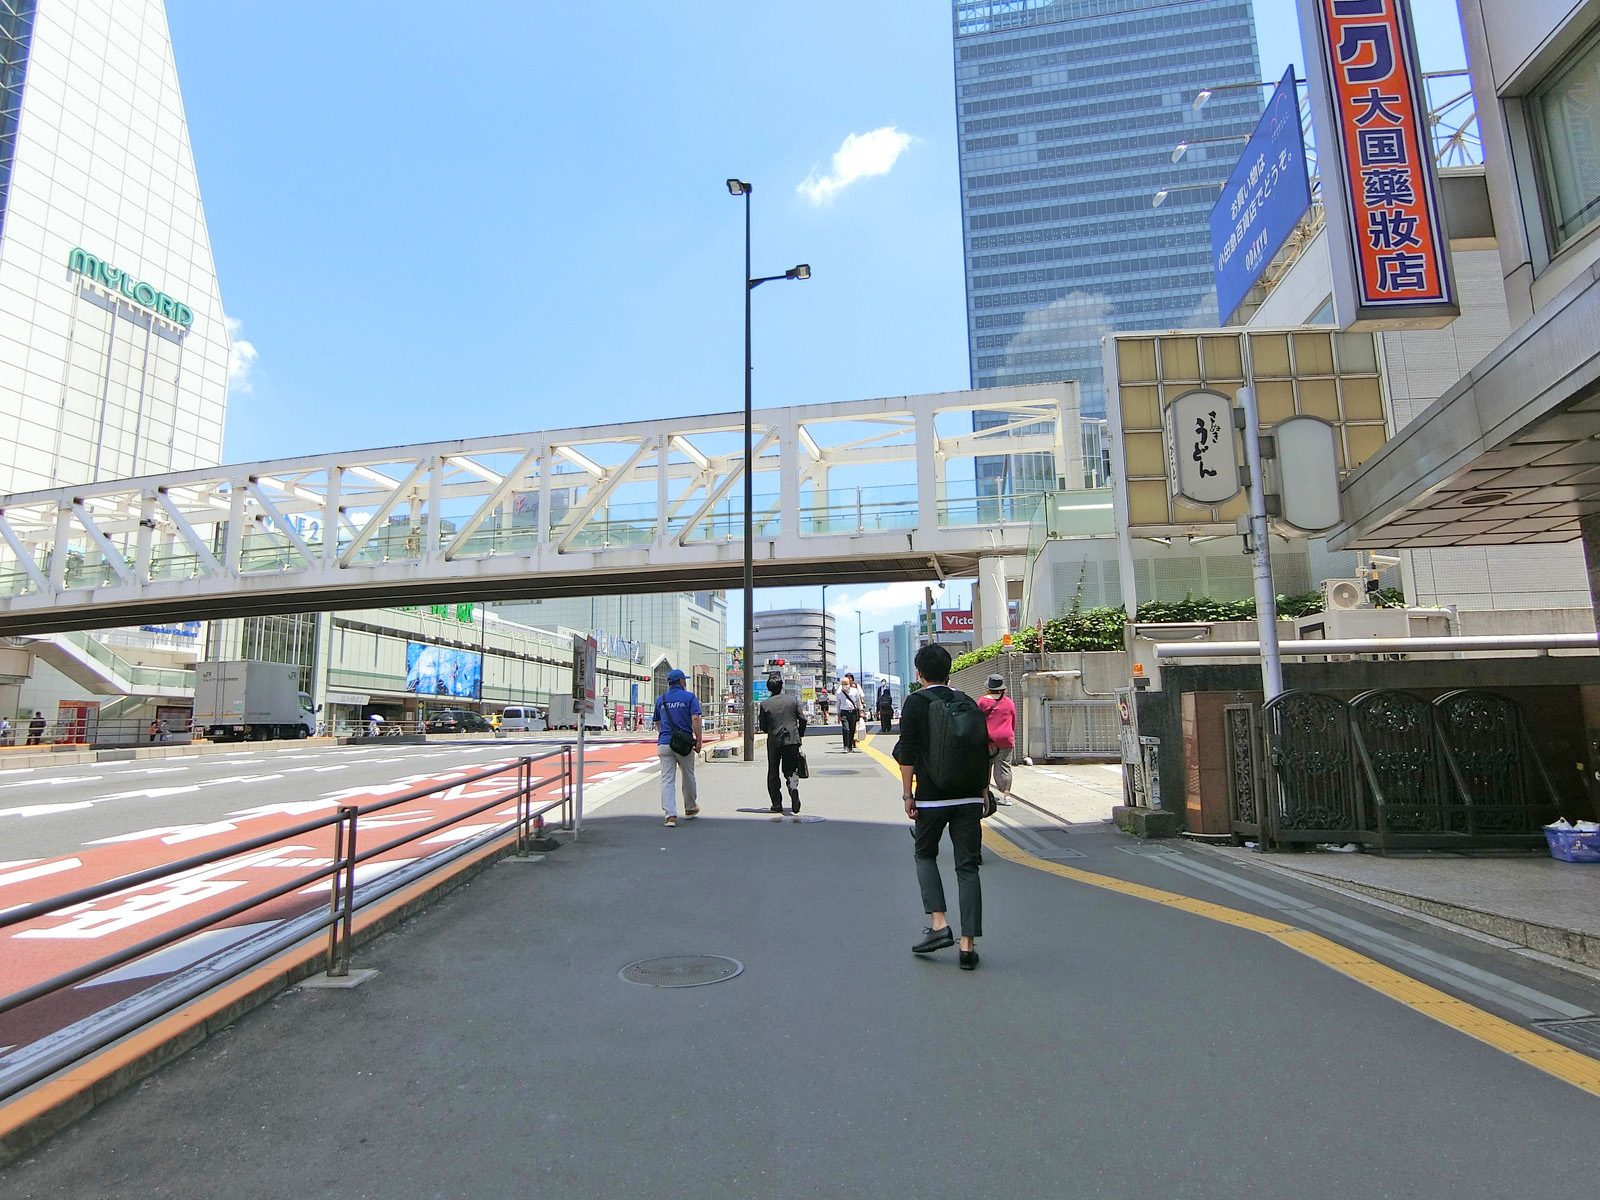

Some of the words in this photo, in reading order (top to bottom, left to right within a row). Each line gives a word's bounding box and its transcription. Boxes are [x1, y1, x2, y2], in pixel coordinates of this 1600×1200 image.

[1218, 147, 1292, 272] 小田急百貨店でどうぞ。
[1231, 152, 1266, 221] お買い物は
[1245, 227, 1268, 271] ODAKYU
[68, 247, 195, 328] MYLORD
[1192, 417, 1218, 479] うどん
[1208, 410, 1221, 444] さぬき
[946, 615, 974, 625] Victo
[288, 671, 297, 679] JR
